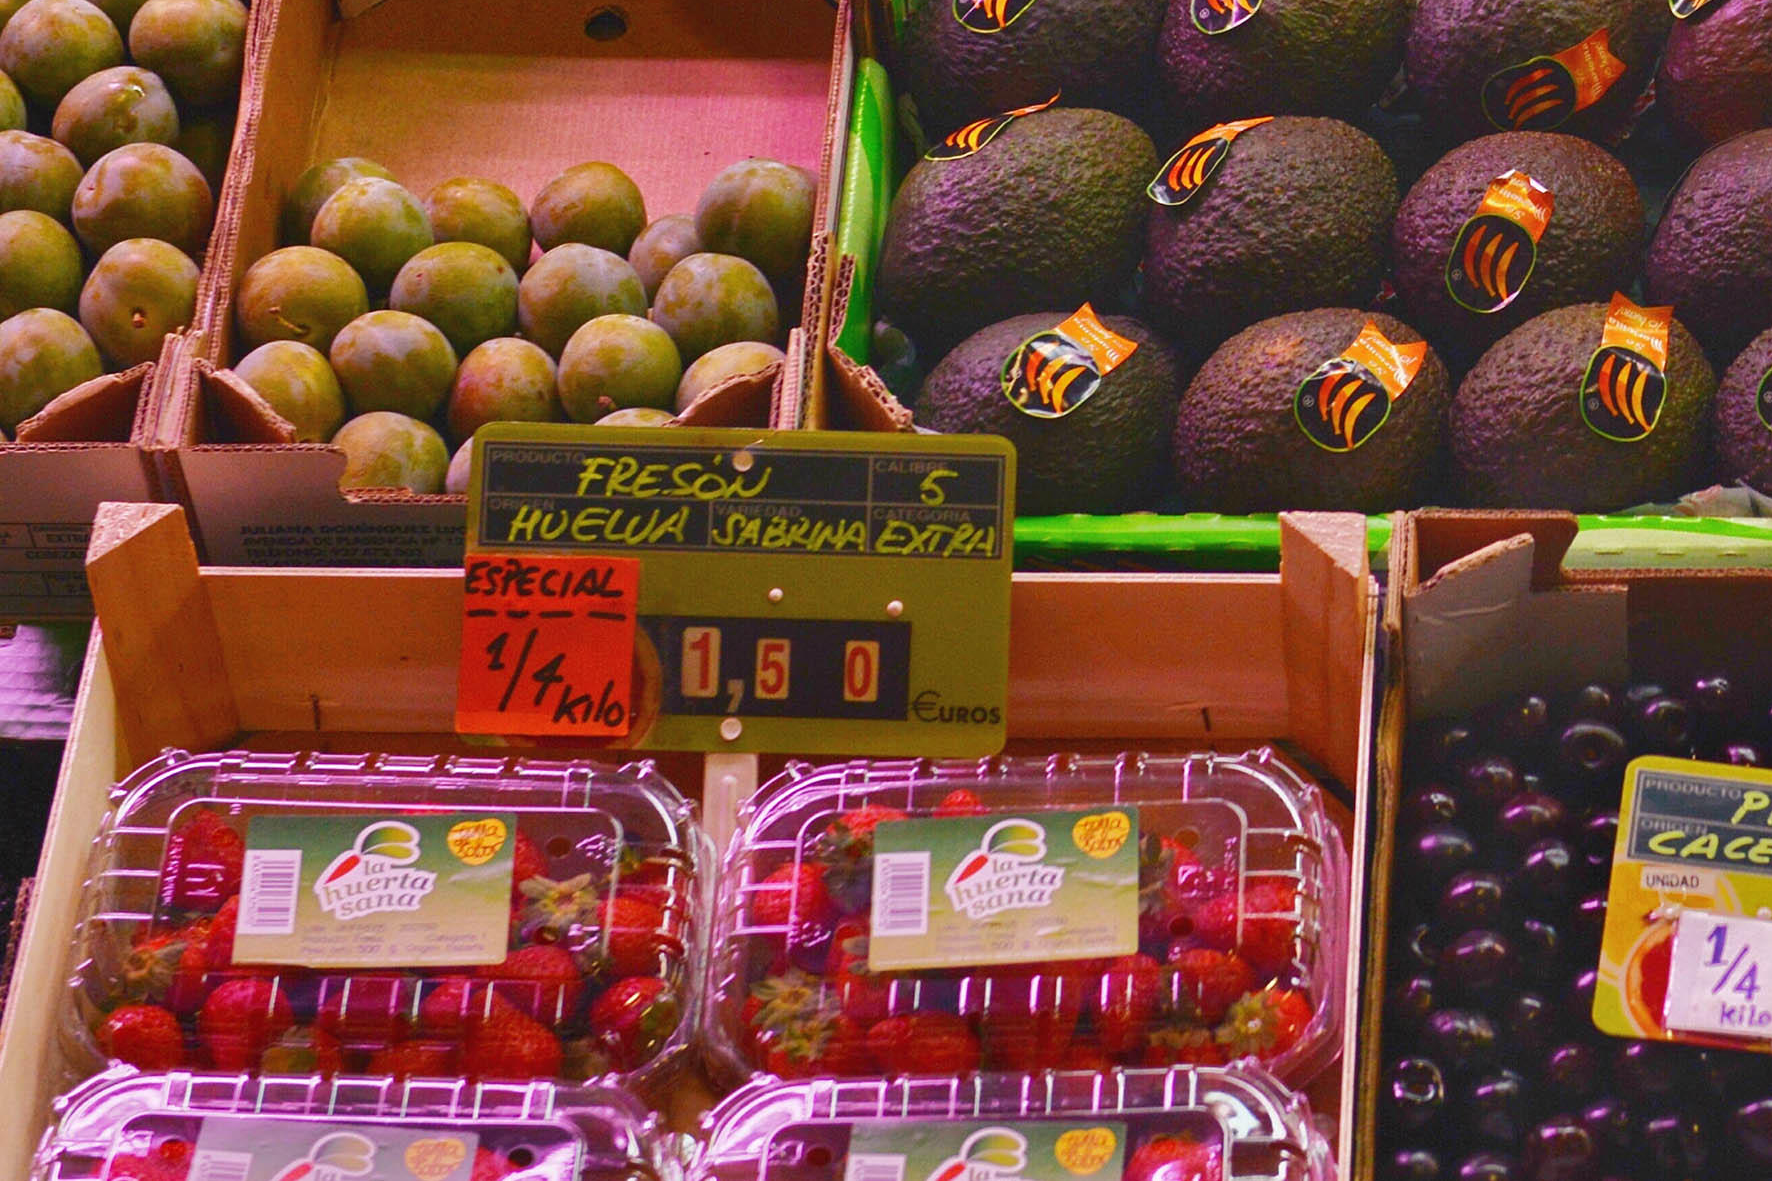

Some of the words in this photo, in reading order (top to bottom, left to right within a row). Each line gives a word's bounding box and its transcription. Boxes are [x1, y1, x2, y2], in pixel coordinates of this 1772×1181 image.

[919, 469, 959, 507] 5
[711, 512, 867, 552] SABRINA
[464, 559, 624, 599] ESPECIAL
[1644, 872, 1701, 889] UNIDAD
